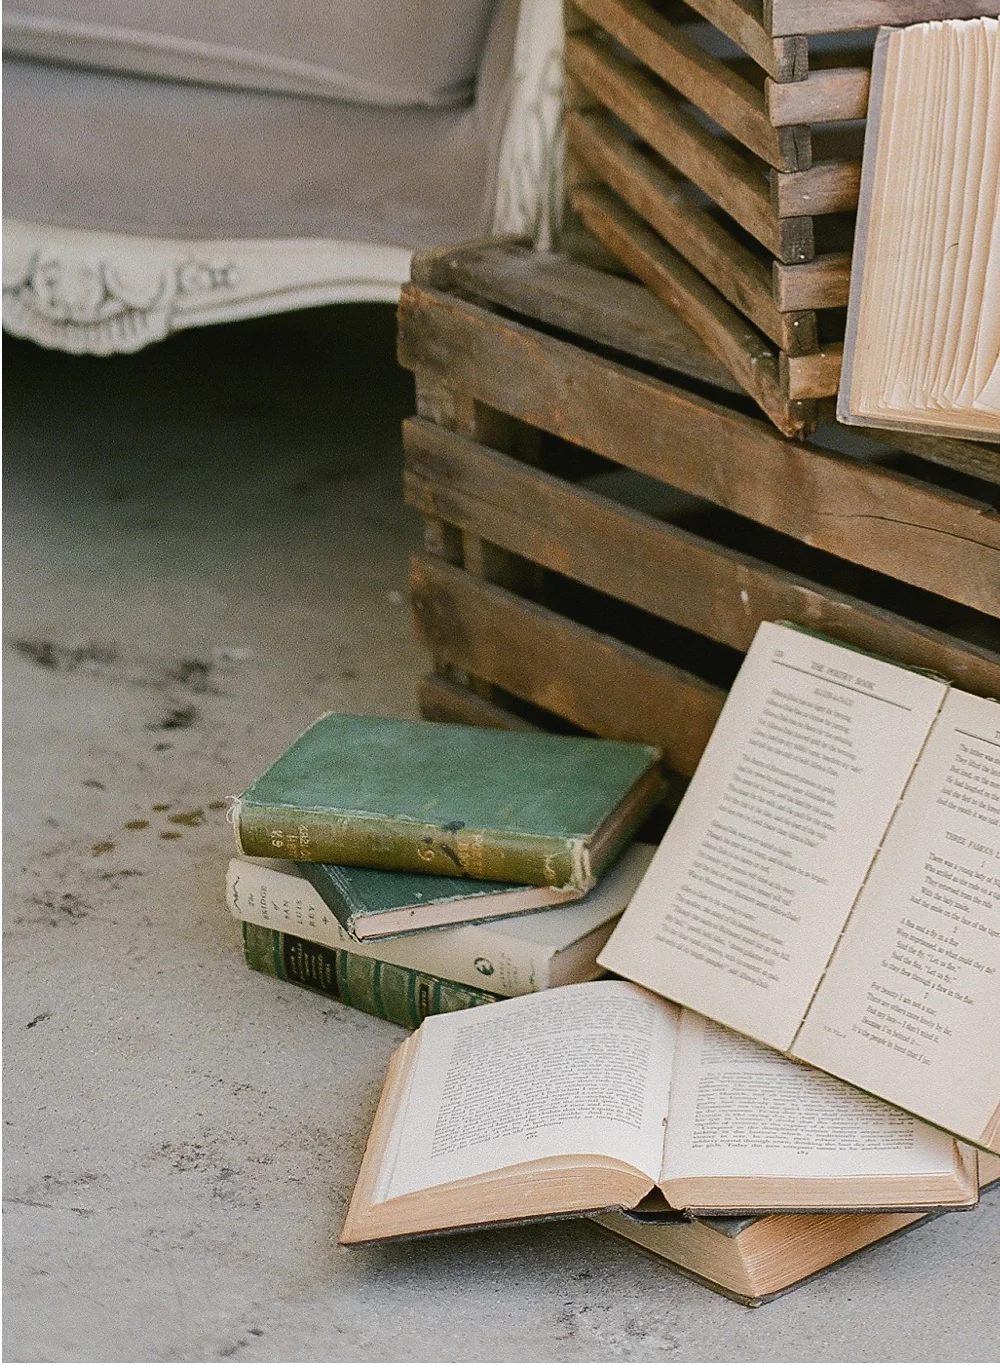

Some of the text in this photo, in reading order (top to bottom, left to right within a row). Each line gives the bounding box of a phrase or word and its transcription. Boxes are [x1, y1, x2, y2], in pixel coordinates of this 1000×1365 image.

[811, 662, 824, 672] THE
[946, 831, 966, 845] THREE
[968, 841, 993, 856] FAMOUS
[260, 885, 270, 920] BRIDGE
